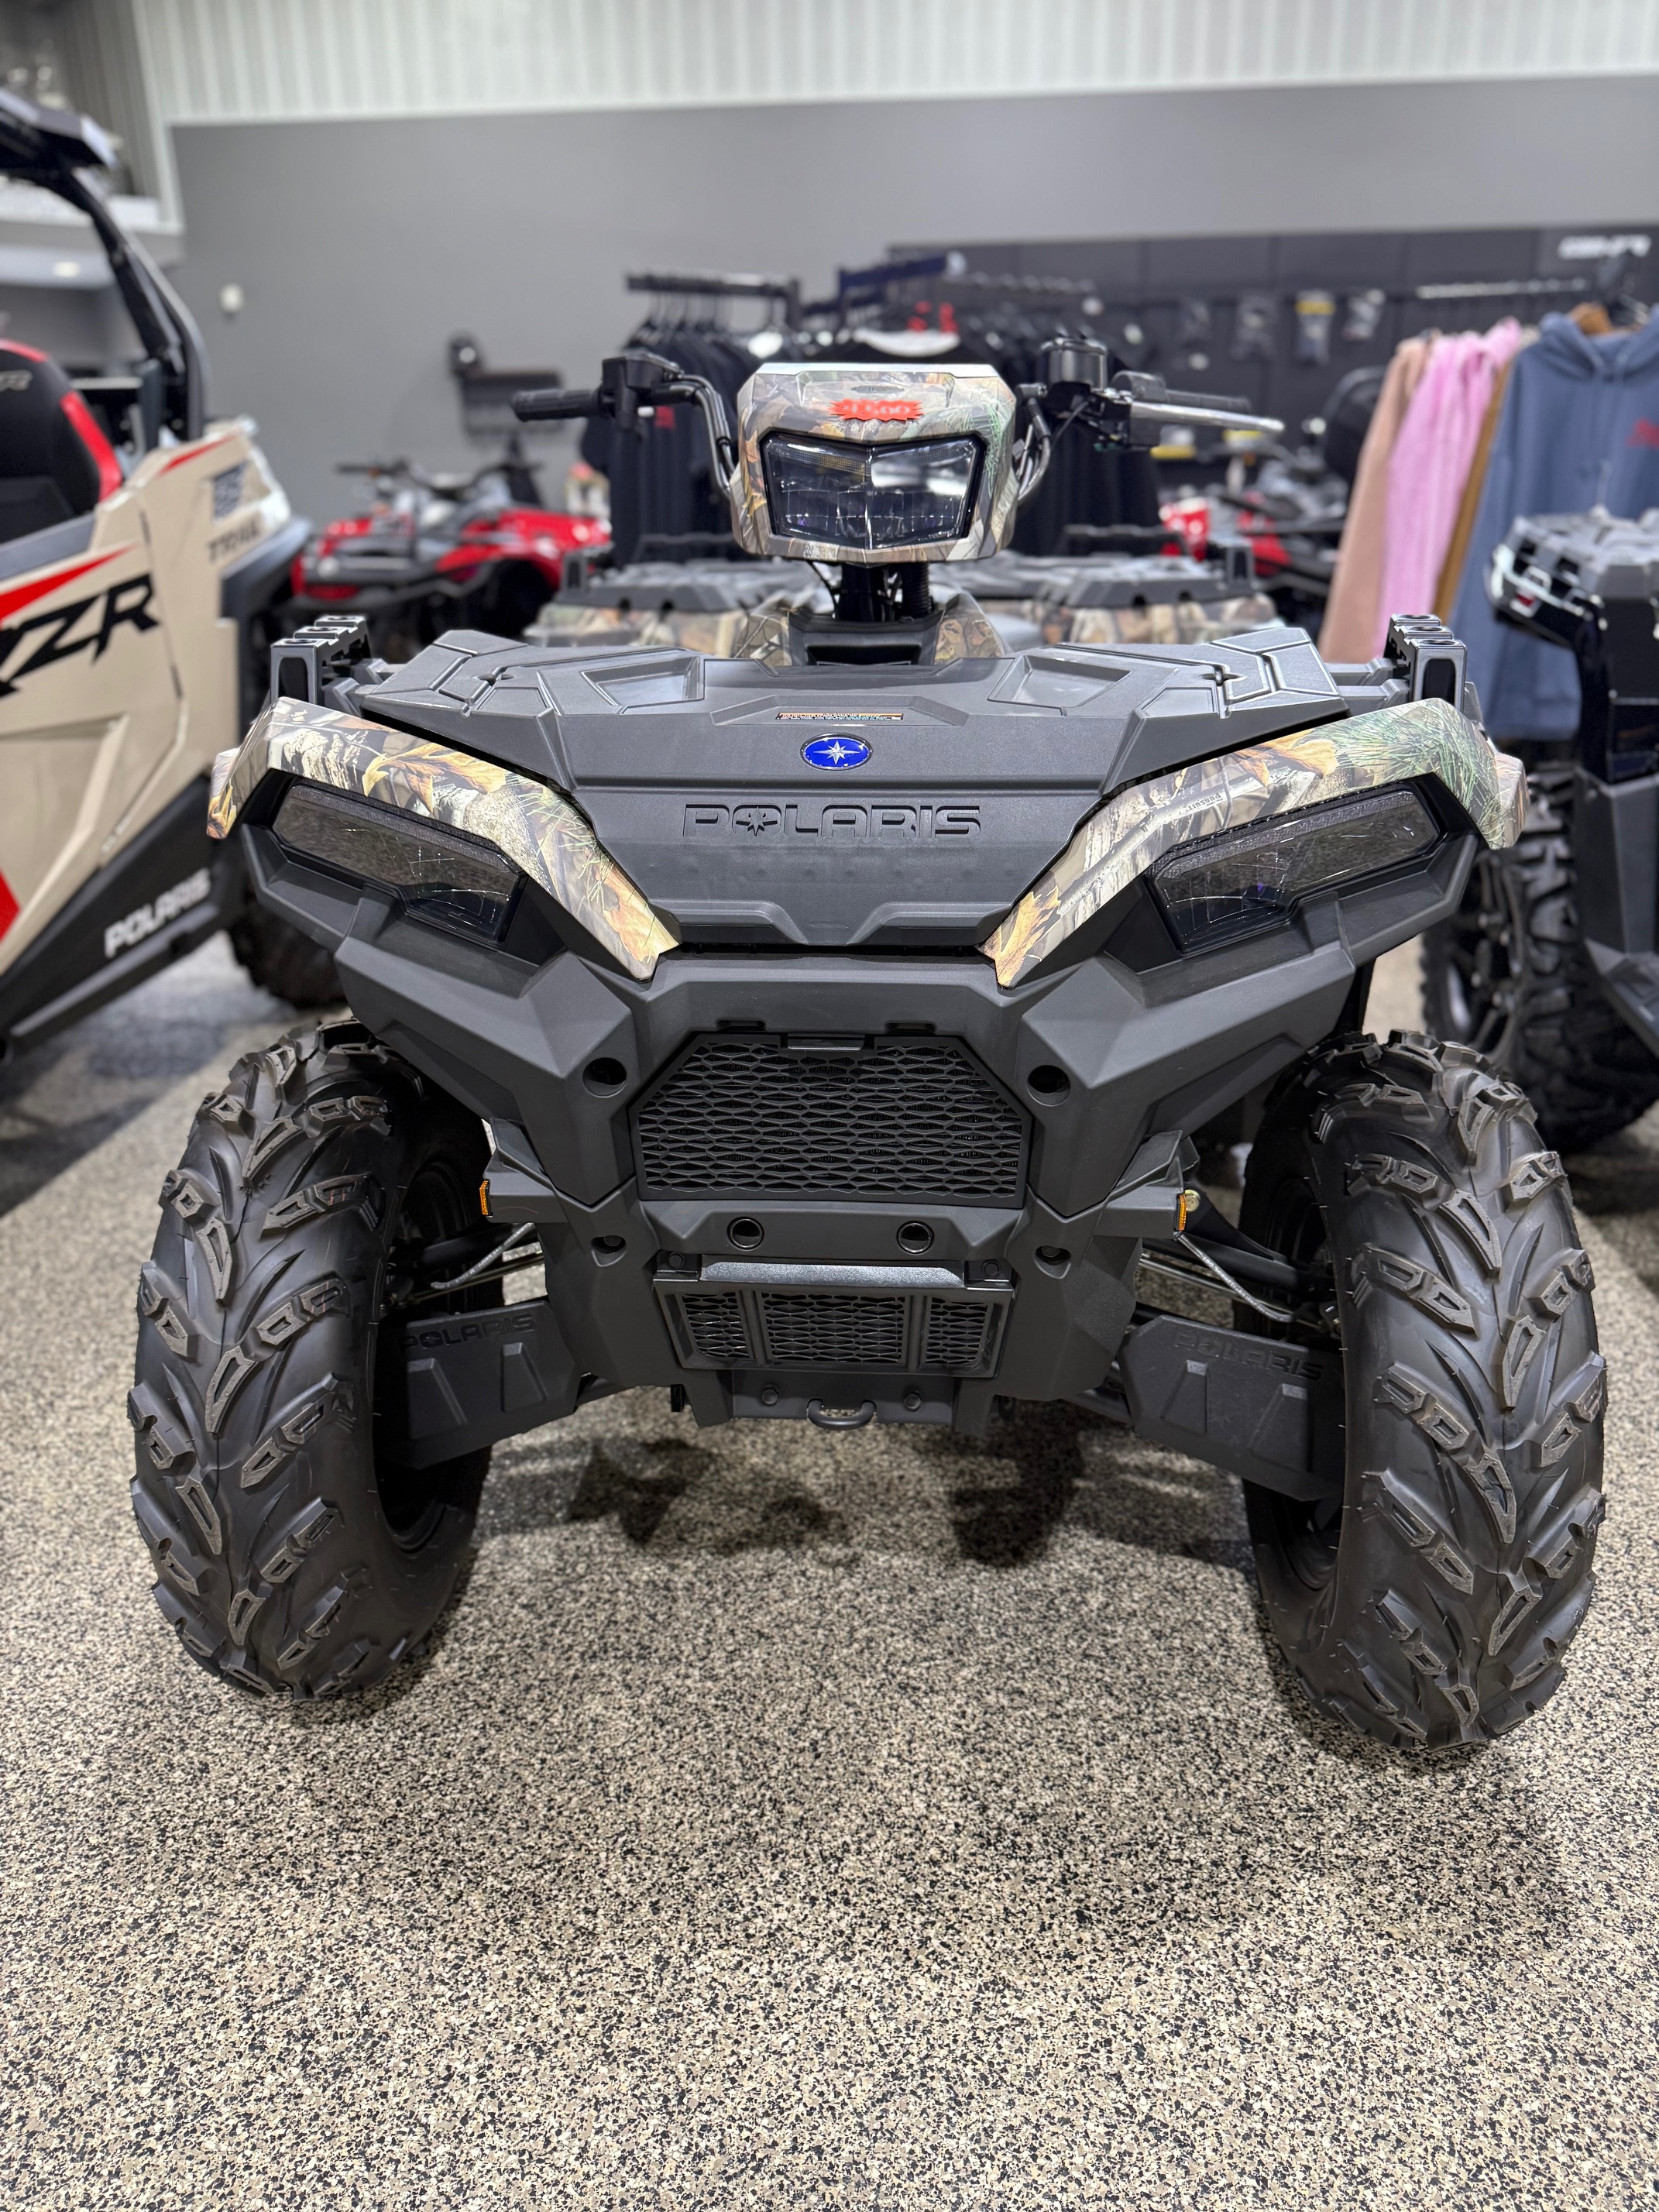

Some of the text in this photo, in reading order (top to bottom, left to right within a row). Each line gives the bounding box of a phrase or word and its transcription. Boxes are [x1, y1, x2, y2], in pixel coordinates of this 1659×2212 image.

[682, 804, 981, 838] POLARIS
[105, 867, 211, 958] POLARIS
[402, 1314, 536, 1349] POLARIS
[1175, 1330, 1324, 1380] POLARIS
